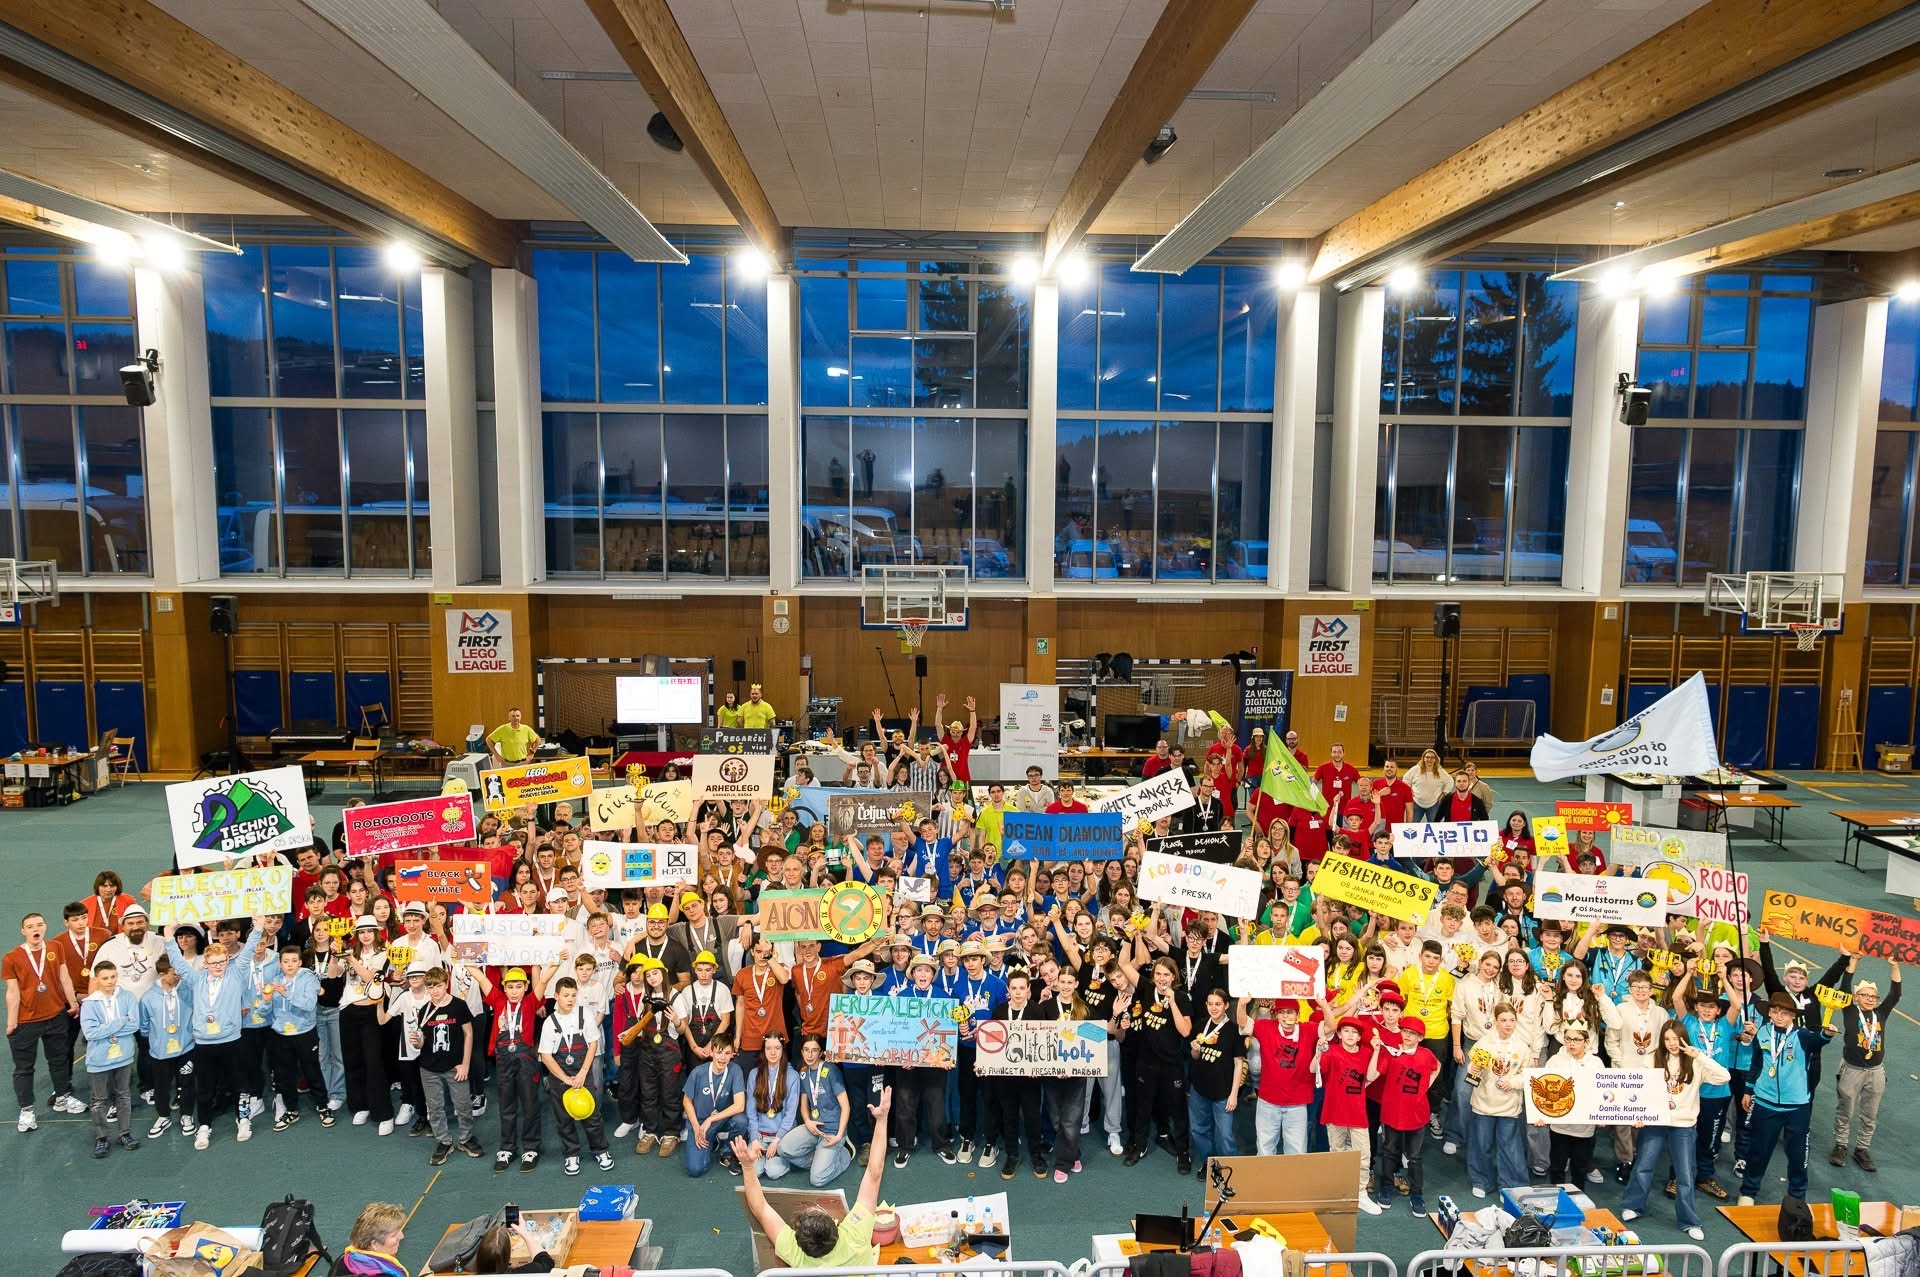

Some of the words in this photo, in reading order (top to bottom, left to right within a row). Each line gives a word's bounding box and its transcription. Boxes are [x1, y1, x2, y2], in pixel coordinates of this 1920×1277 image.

[458, 636, 502, 647] FIRST
[1309, 640, 1350, 652] FIRST
[461, 649, 497, 658] LEGO
[1312, 653, 1345, 662] LEGO
[455, 660, 507, 670] LEAGUE
[1305, 664, 1352, 674] LEAGUE
[1245, 690, 1256, 698] ZA
[1257, 687, 1282, 698] VEČJO
[1245, 697, 1287, 706] DIGITALNO
[526, 767, 548, 777] LEGO
[705, 784, 760, 792] ARHEOLEGO
[1137, 778, 1190, 800] ANGELS
[1558, 806, 1598, 817] ROBOSONČKI
[220, 814, 279, 839] TECHNO
[353, 811, 435, 830] ROBOROOTS
[1573, 816, 1594, 825] KOPER
[221, 826, 280, 851] DRSKA
[1004, 823, 1054, 841] OCEAN
[1059, 824, 1123, 843] DIAMOND
[1611, 827, 1662, 846] LEGO
[157, 868, 282, 897] ELECTRO
[1321, 857, 1432, 902] FISHERBOSS
[1700, 868, 1747, 895] ROBO
[428, 886, 461, 894] WHITE
[1182, 888, 1212, 901] PRESKA
[1340, 880, 1351, 889] OŠ
[1352, 884, 1375, 897] JANKA
[152, 890, 289, 921] MASTERS
[1565, 893, 1634, 906] Mountstorms
[1769, 893, 1797, 908] GO
[765, 901, 820, 931] AION
[1801, 910, 1859, 938] KINGS
[1285, 984, 1310, 995] ROBO
[1058, 1039, 1095, 1064] 404
[1595, 1072, 1627, 1080] Osnovna
[1628, 1072, 1643, 1080] šola
[1596, 1081, 1619, 1089] Danile
[1623, 1105, 1647, 1113] Kumar
[1635, 1114, 1659, 1122] school
